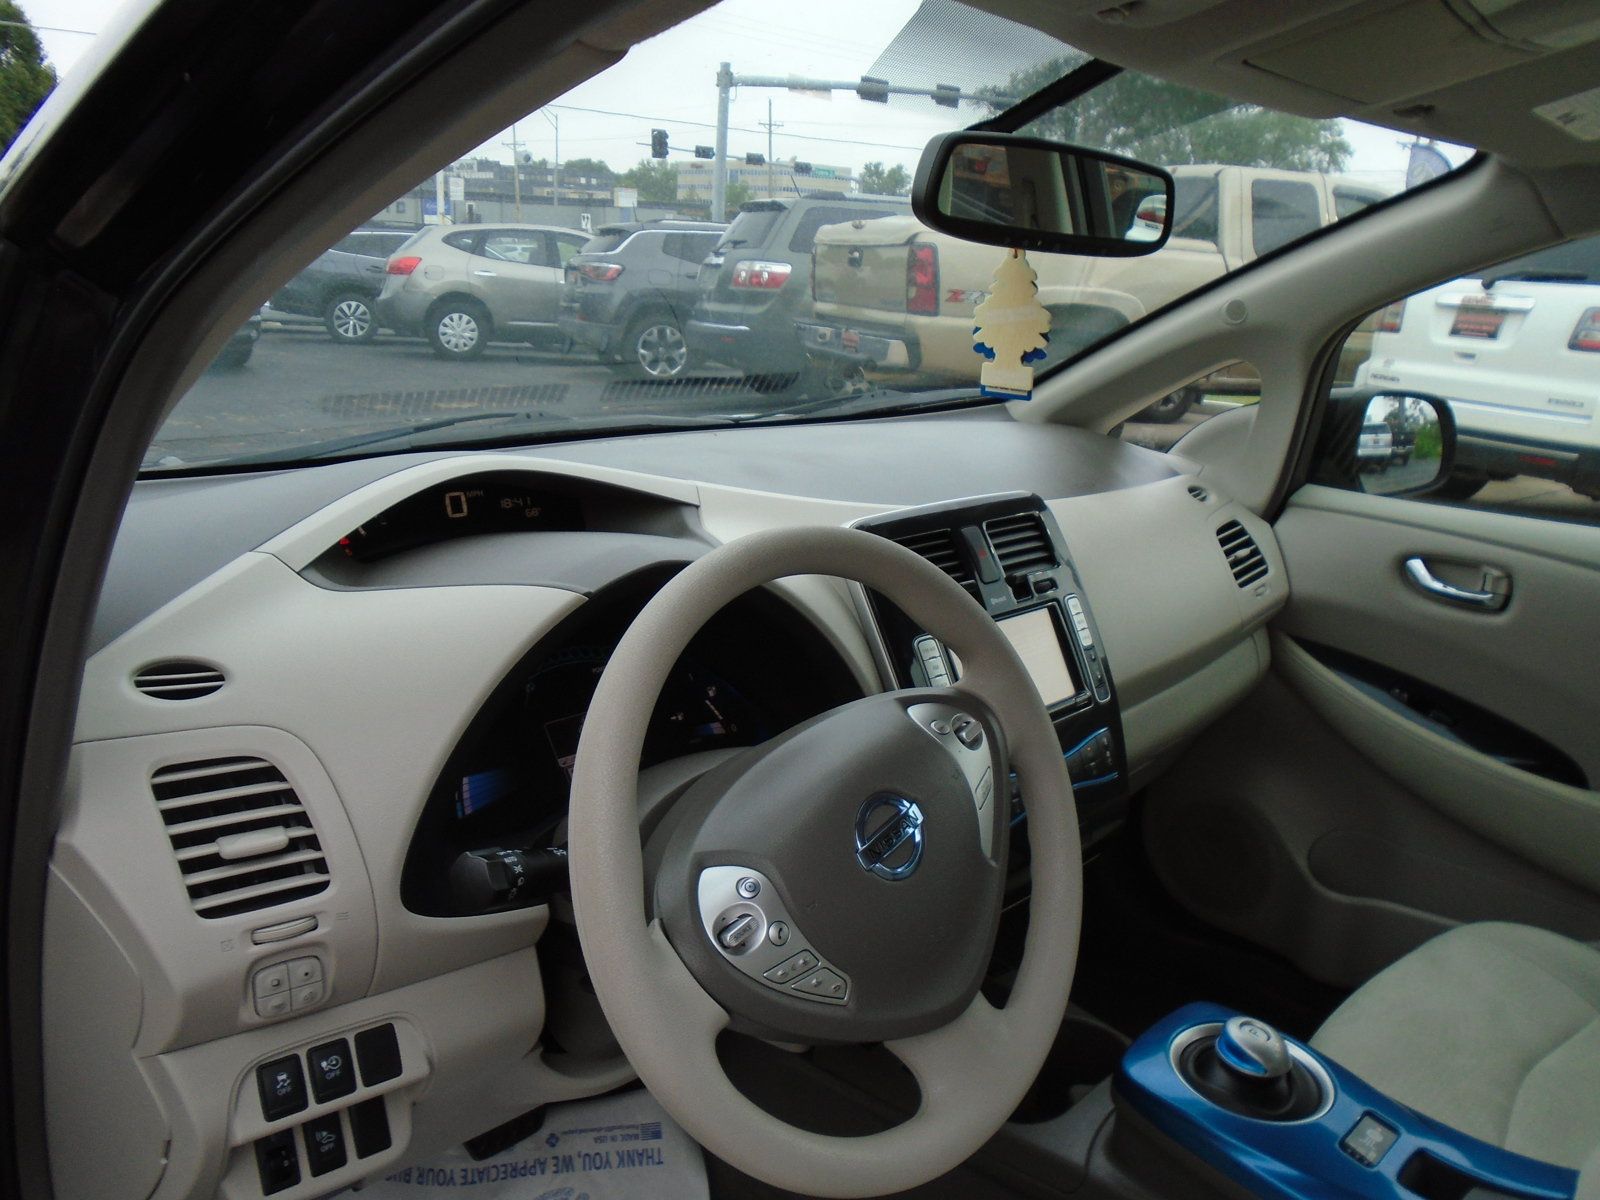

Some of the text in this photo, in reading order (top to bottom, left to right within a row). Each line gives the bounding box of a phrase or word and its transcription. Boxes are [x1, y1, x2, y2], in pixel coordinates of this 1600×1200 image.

[867, 809, 920, 859] NISSAN
[552, 1154, 575, 1174] WE
[577, 1151, 612, 1171] YOU,
[616, 1148, 663, 1169] THANK
[416, 1166, 457, 1187] YOUR
[460, 1157, 548, 1186] APPRECIATE
